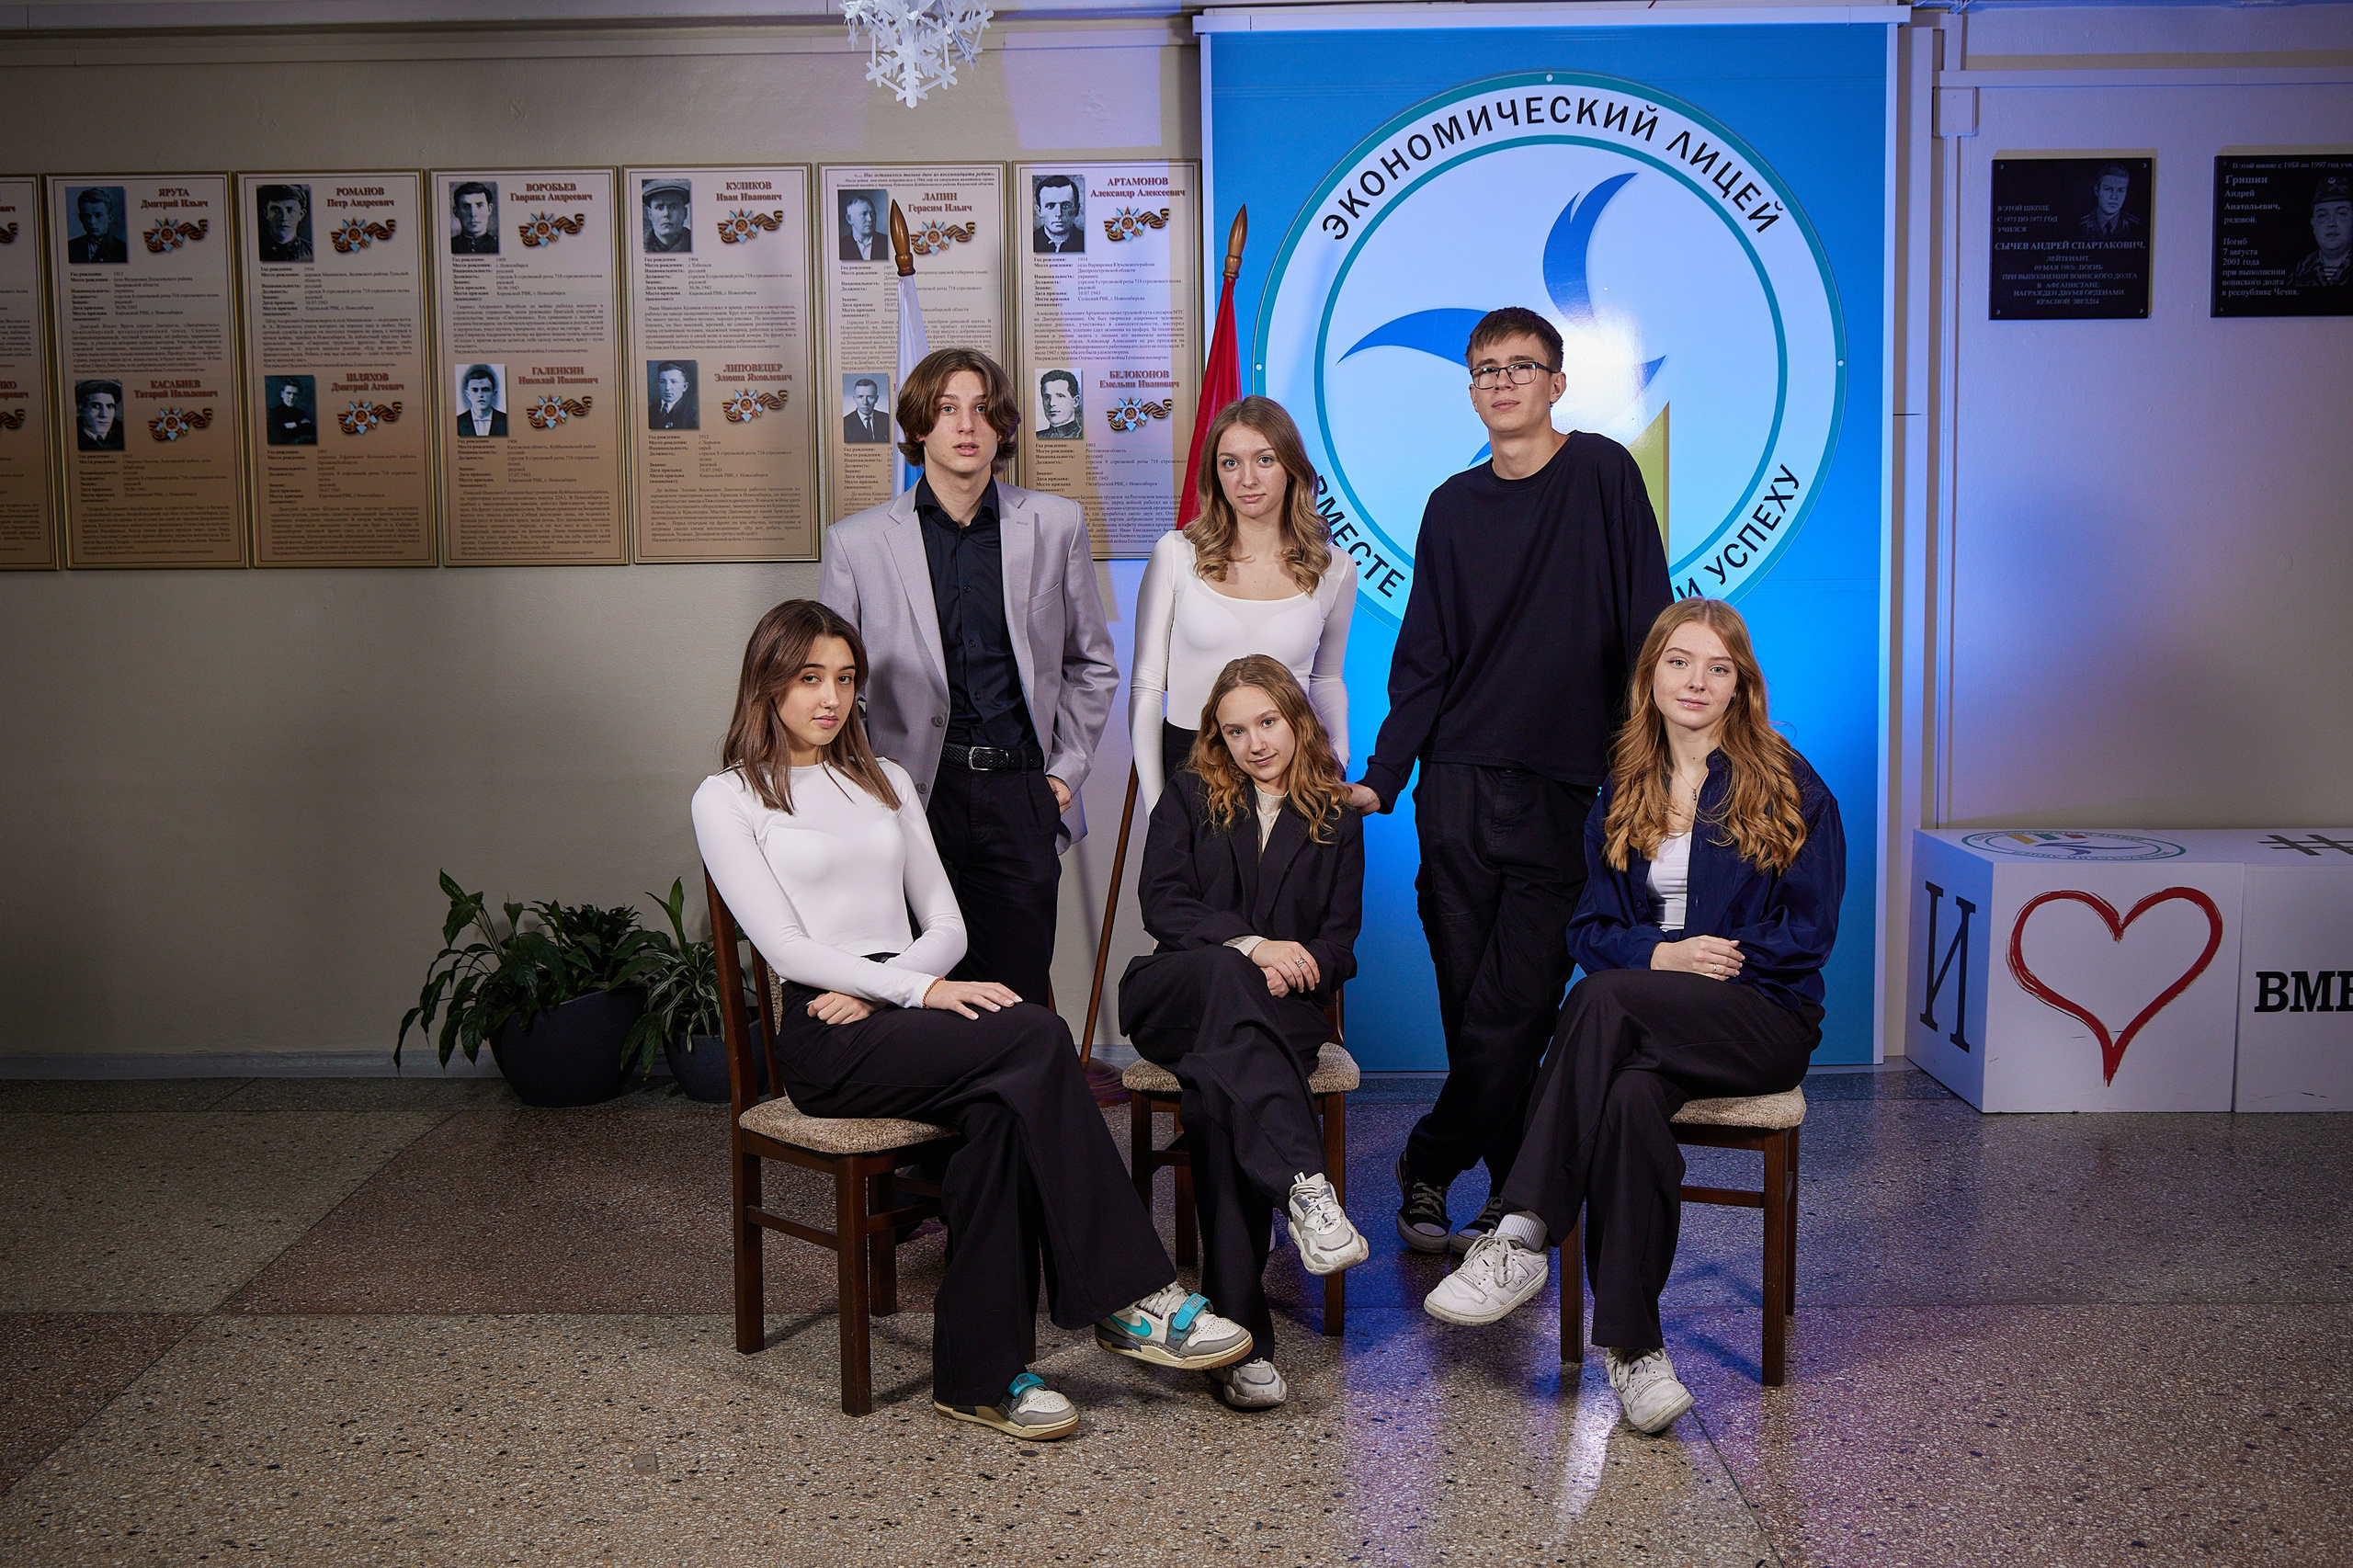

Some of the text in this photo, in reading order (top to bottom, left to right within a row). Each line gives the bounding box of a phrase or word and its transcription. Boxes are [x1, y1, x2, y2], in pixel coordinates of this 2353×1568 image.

[1321, 96, 1785, 241] ЭКОНОМИЧЕСКИЙ ЛИЦЕЙ
[2339, 162, 2353, 170] учи
[726, 181, 772, 190] КУЛИКОВ
[1107, 177, 1168, 187] АРТАМОНОВ
[2225, 175, 2268, 187] Гришин
[158, 187, 189, 197] ЯРУТА
[336, 187, 385, 196] РОМАНОВ
[526, 182, 576, 192] ВОРОБЬЕВ
[510, 193, 593, 202] Гавриил Андреевич
[716, 193, 782, 201] Иван Иванович
[922, 192, 958, 201] ЛАПИН
[1090, 188, 1186, 199] Александр Алексеевич
[2224, 189, 2256, 199] Андрей
[141, 199, 208, 210] Дмитрий Ильич
[327, 199, 394, 209] Петр Андреевич
[908, 203, 972, 214] Герасим Ильич
[2223, 203, 2280, 211] Анатольевич,
[2223, 216, 2257, 225] рядовой.
[1995, 242, 2029, 250] СЫЧЕВ
[2030, 240, 2070, 251] АНДРЕЙ
[2223, 237, 2248, 246] Погиб
[2229, 249, 2258, 257] августа
[2222, 258, 2240, 267] 2001
[2228, 289, 2272, 298] республике
[532, 367, 585, 375] ГАЛЕНКИН
[723, 363, 783, 373] ЛИПОВЕЦЕР
[347, 372, 389, 381] ШЛЯХОВ
[746, 373, 792, 381] Яковлевич
[1109, 369, 1169, 379] БЕЛОКОНОВ
[151, 380, 201, 390] КАСАБИЕВ
[518, 376, 598, 385] Николай Иванович
[1099, 380, 1179, 389] Емельян Иванович
[331, 382, 404, 392] Дмитрий Агеевич
[133, 390, 169, 400] Татарий
[1704, 462, 1800, 585] УСПЕХУ
[1920, 880, 1976, 1055] И
